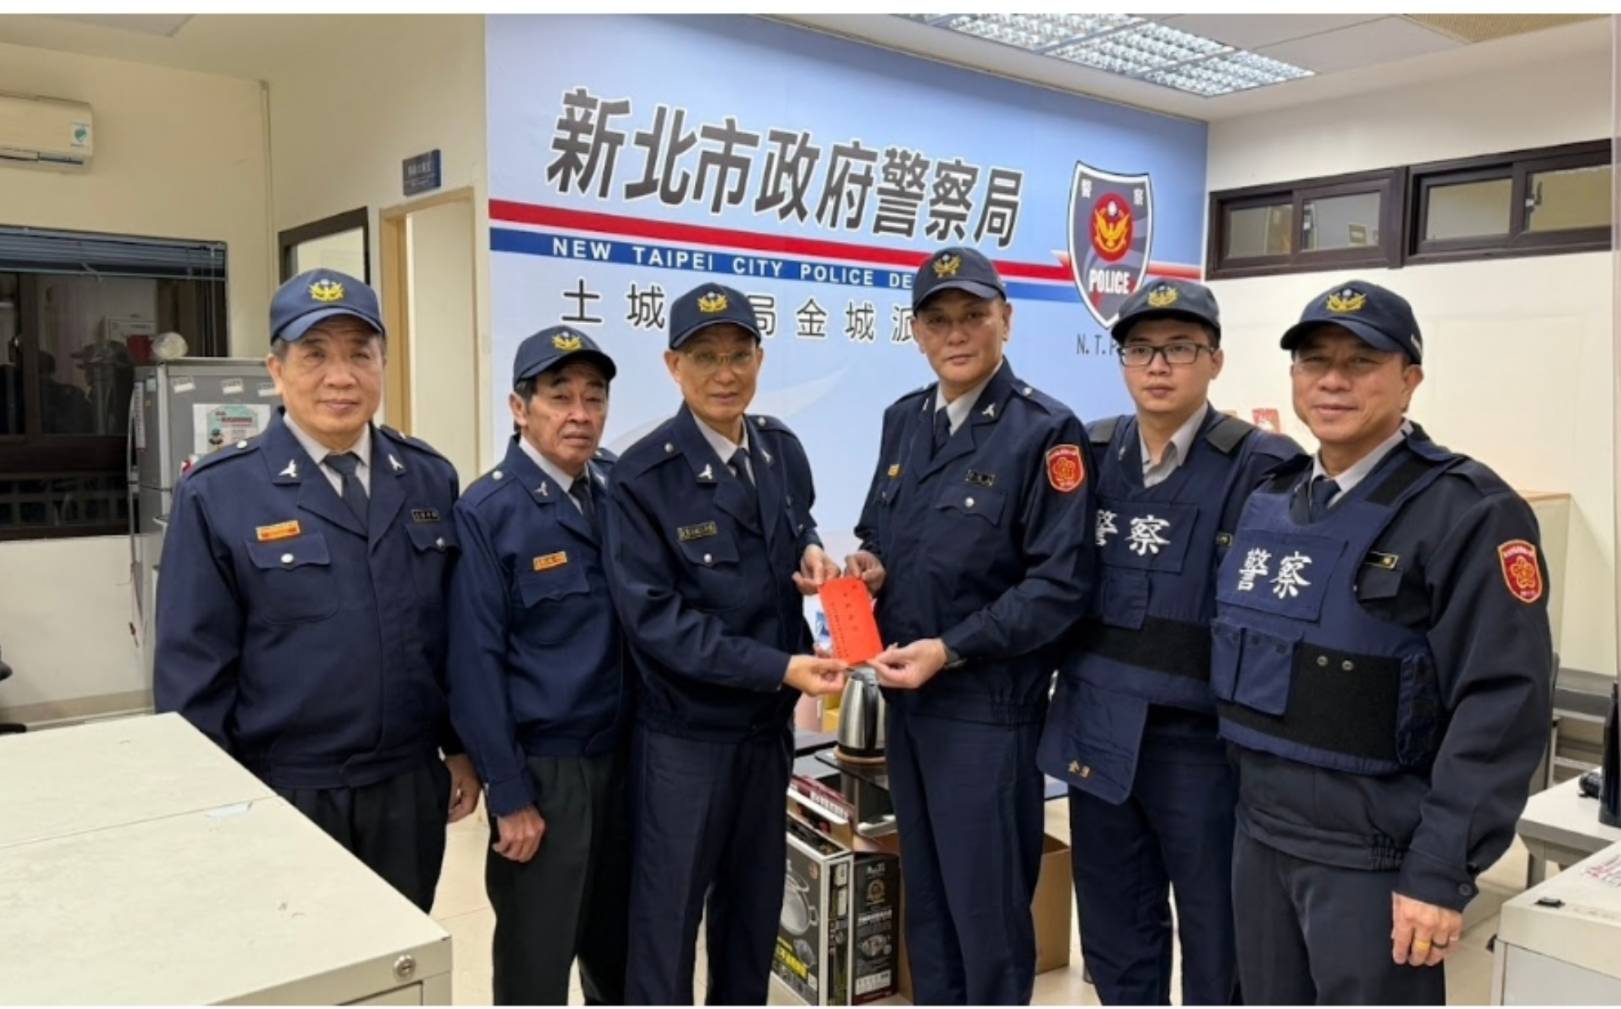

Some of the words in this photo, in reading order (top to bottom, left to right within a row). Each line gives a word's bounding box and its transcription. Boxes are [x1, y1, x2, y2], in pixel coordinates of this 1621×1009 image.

[547, 88, 1025, 247] 新北市政府警察局
[553, 238, 613, 260] NEW
[633, 247, 714, 271] TAIPEI
[733, 257, 783, 278] CITY
[800, 263, 873, 286] POLICE
[889, 273, 913, 289] DE
[1089, 269, 1131, 294] POLICE
[1237, 547, 1313, 600] 警察
